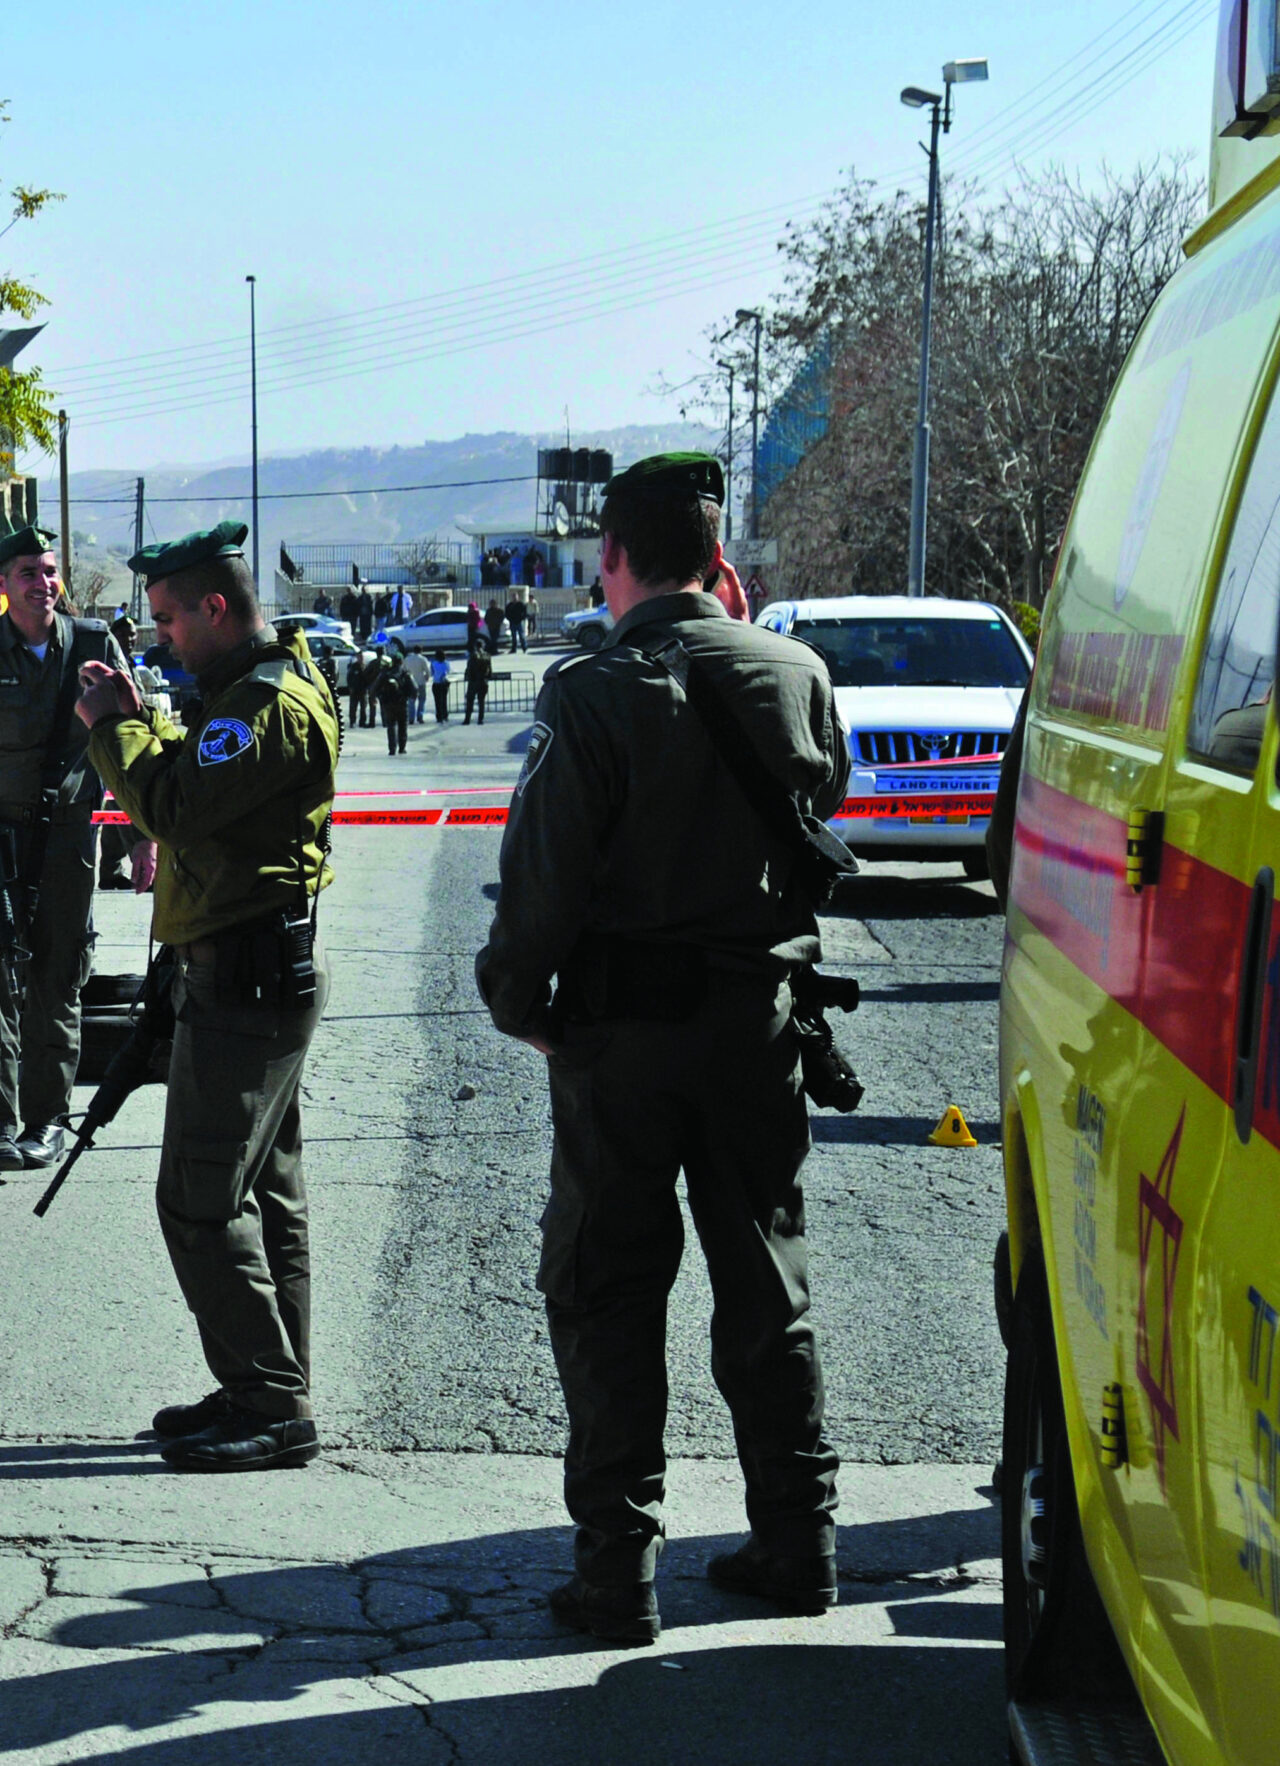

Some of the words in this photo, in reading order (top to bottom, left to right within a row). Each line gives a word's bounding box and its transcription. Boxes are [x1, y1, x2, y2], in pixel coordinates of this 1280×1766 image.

[890, 781, 927, 790] LAND
[929, 780, 991, 790] CRUISER
[952, 1118, 960, 1134] 8
